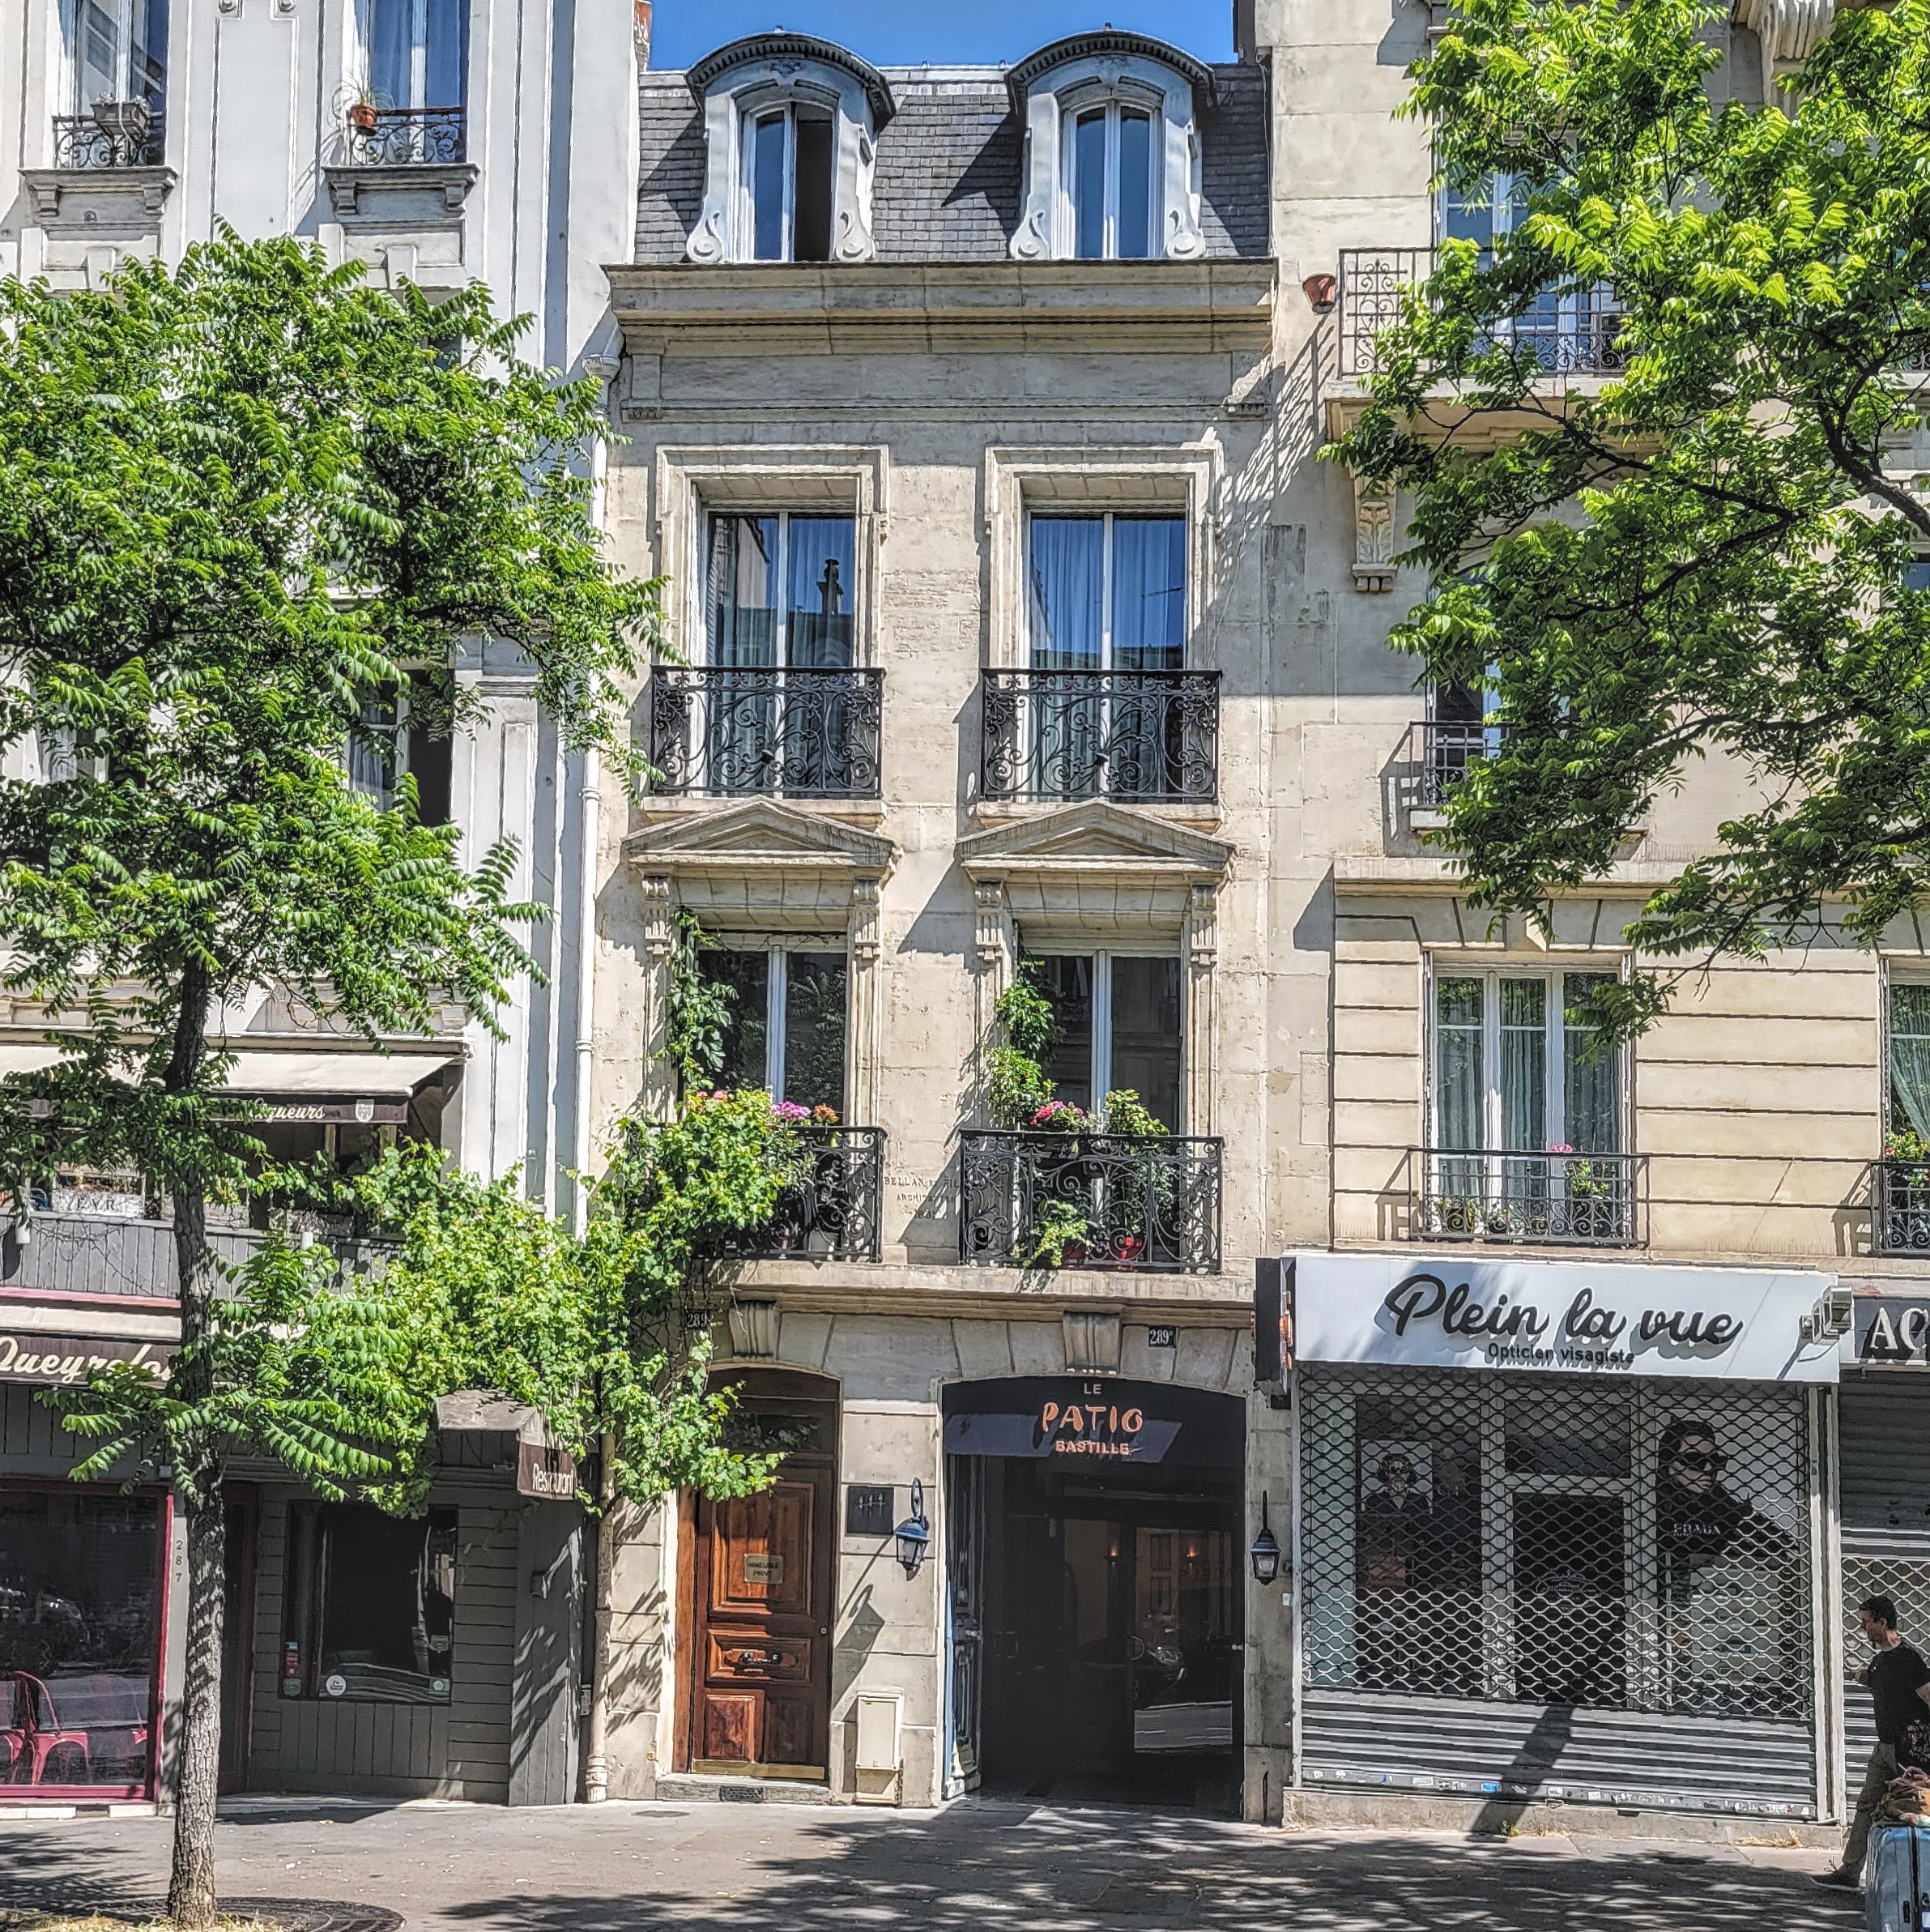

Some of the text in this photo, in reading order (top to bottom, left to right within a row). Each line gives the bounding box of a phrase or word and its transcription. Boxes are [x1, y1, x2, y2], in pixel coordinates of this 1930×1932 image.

[253, 1098, 325, 1123] Lqueurs
[687, 1311, 708, 1328] 289
[1384, 1273, 1743, 1345] Plein la vue
[1488, 1342, 1636, 1365] Opticien visagiste
[1084, 1383, 1101, 1394] LE
[1042, 1401, 1143, 1433] PATIO
[1055, 1440, 1130, 1455] BASTILLE
[175, 1540, 183, 1583] 287
